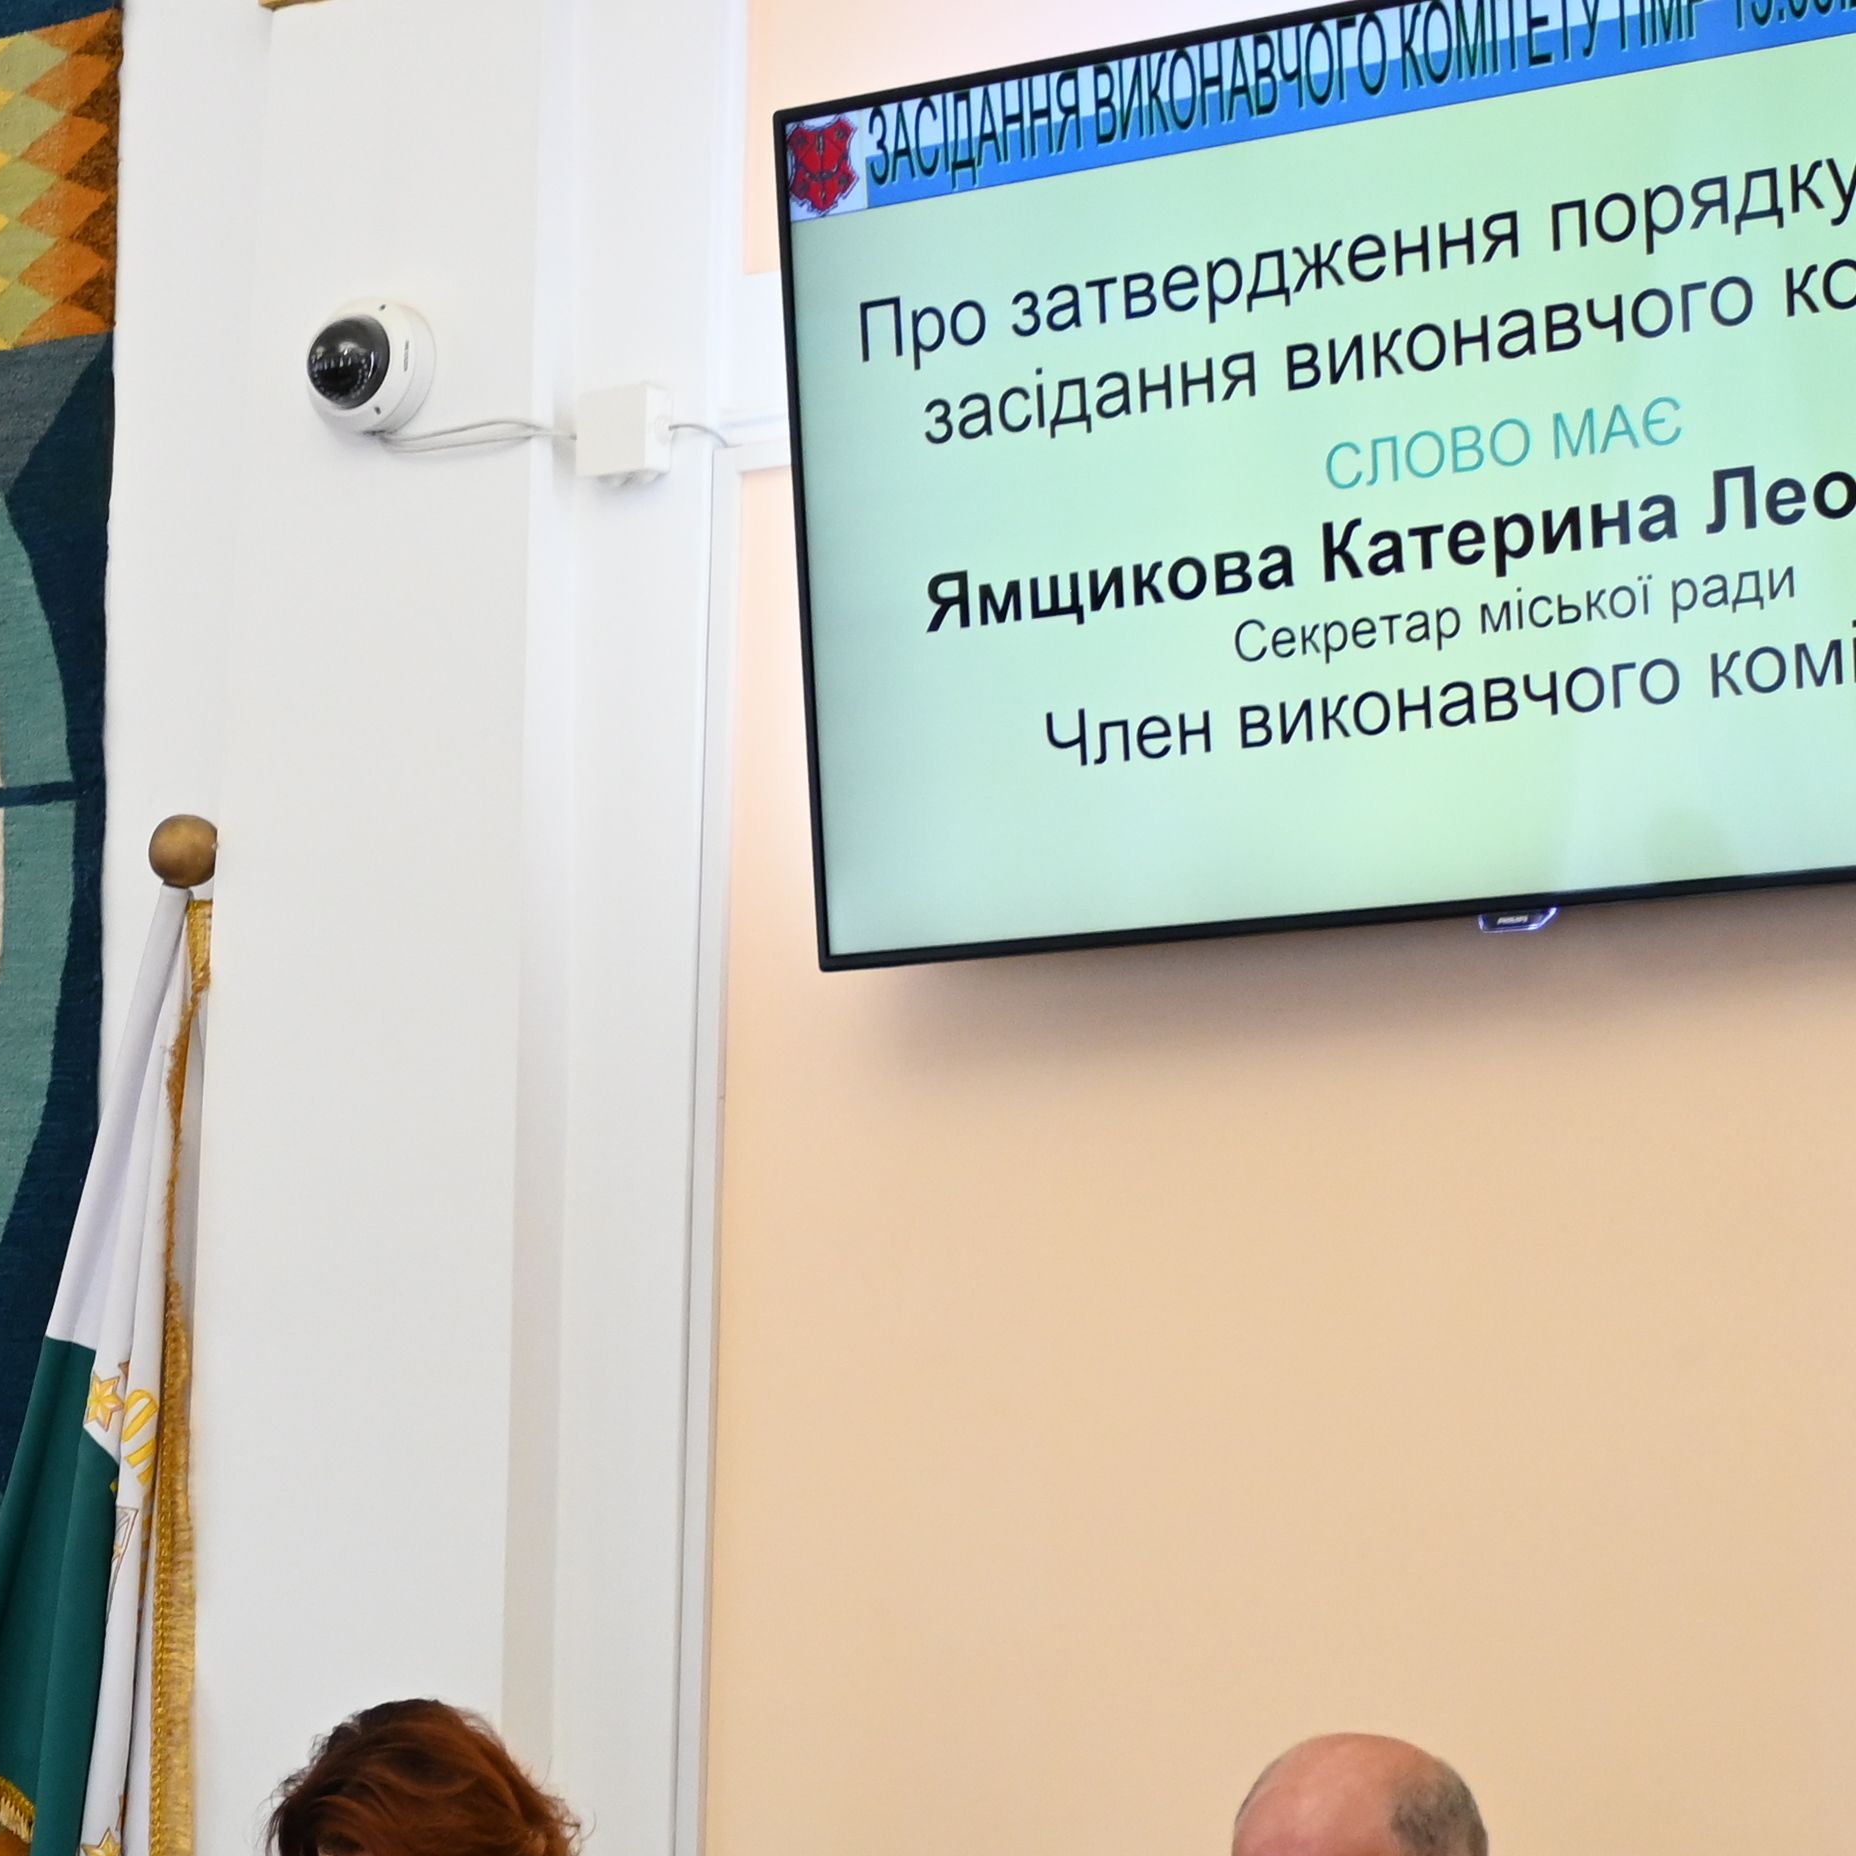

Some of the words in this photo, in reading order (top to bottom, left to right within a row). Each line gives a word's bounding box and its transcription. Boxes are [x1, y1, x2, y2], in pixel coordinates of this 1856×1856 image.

[867, 71, 1083, 189] ЗАСІДАННЯ
[1092, 13, 1388, 146] ВИКОНАВЧОГО
[1399, 0, 1600, 90] КОМІТЕТУ
[859, 296, 986, 370] Про
[1011, 209, 1519, 338] затвердження
[1551, 157, 1856, 256] порядку
[924, 350, 1257, 445] засідання
[1286, 275, 1754, 391] виконавчого
[1325, 418, 1531, 490] СЛОВО
[1552, 396, 1683, 460] МАЄ
[926, 543, 1295, 634] Ямщикова
[1322, 493, 1678, 582] Катерина
[1235, 605, 1461, 663] Секретар
[1480, 574, 1653, 634] міської
[1671, 566, 1796, 624] ради
[1045, 708, 1212, 767] Член
[1239, 658, 1680, 750] виконавчого
